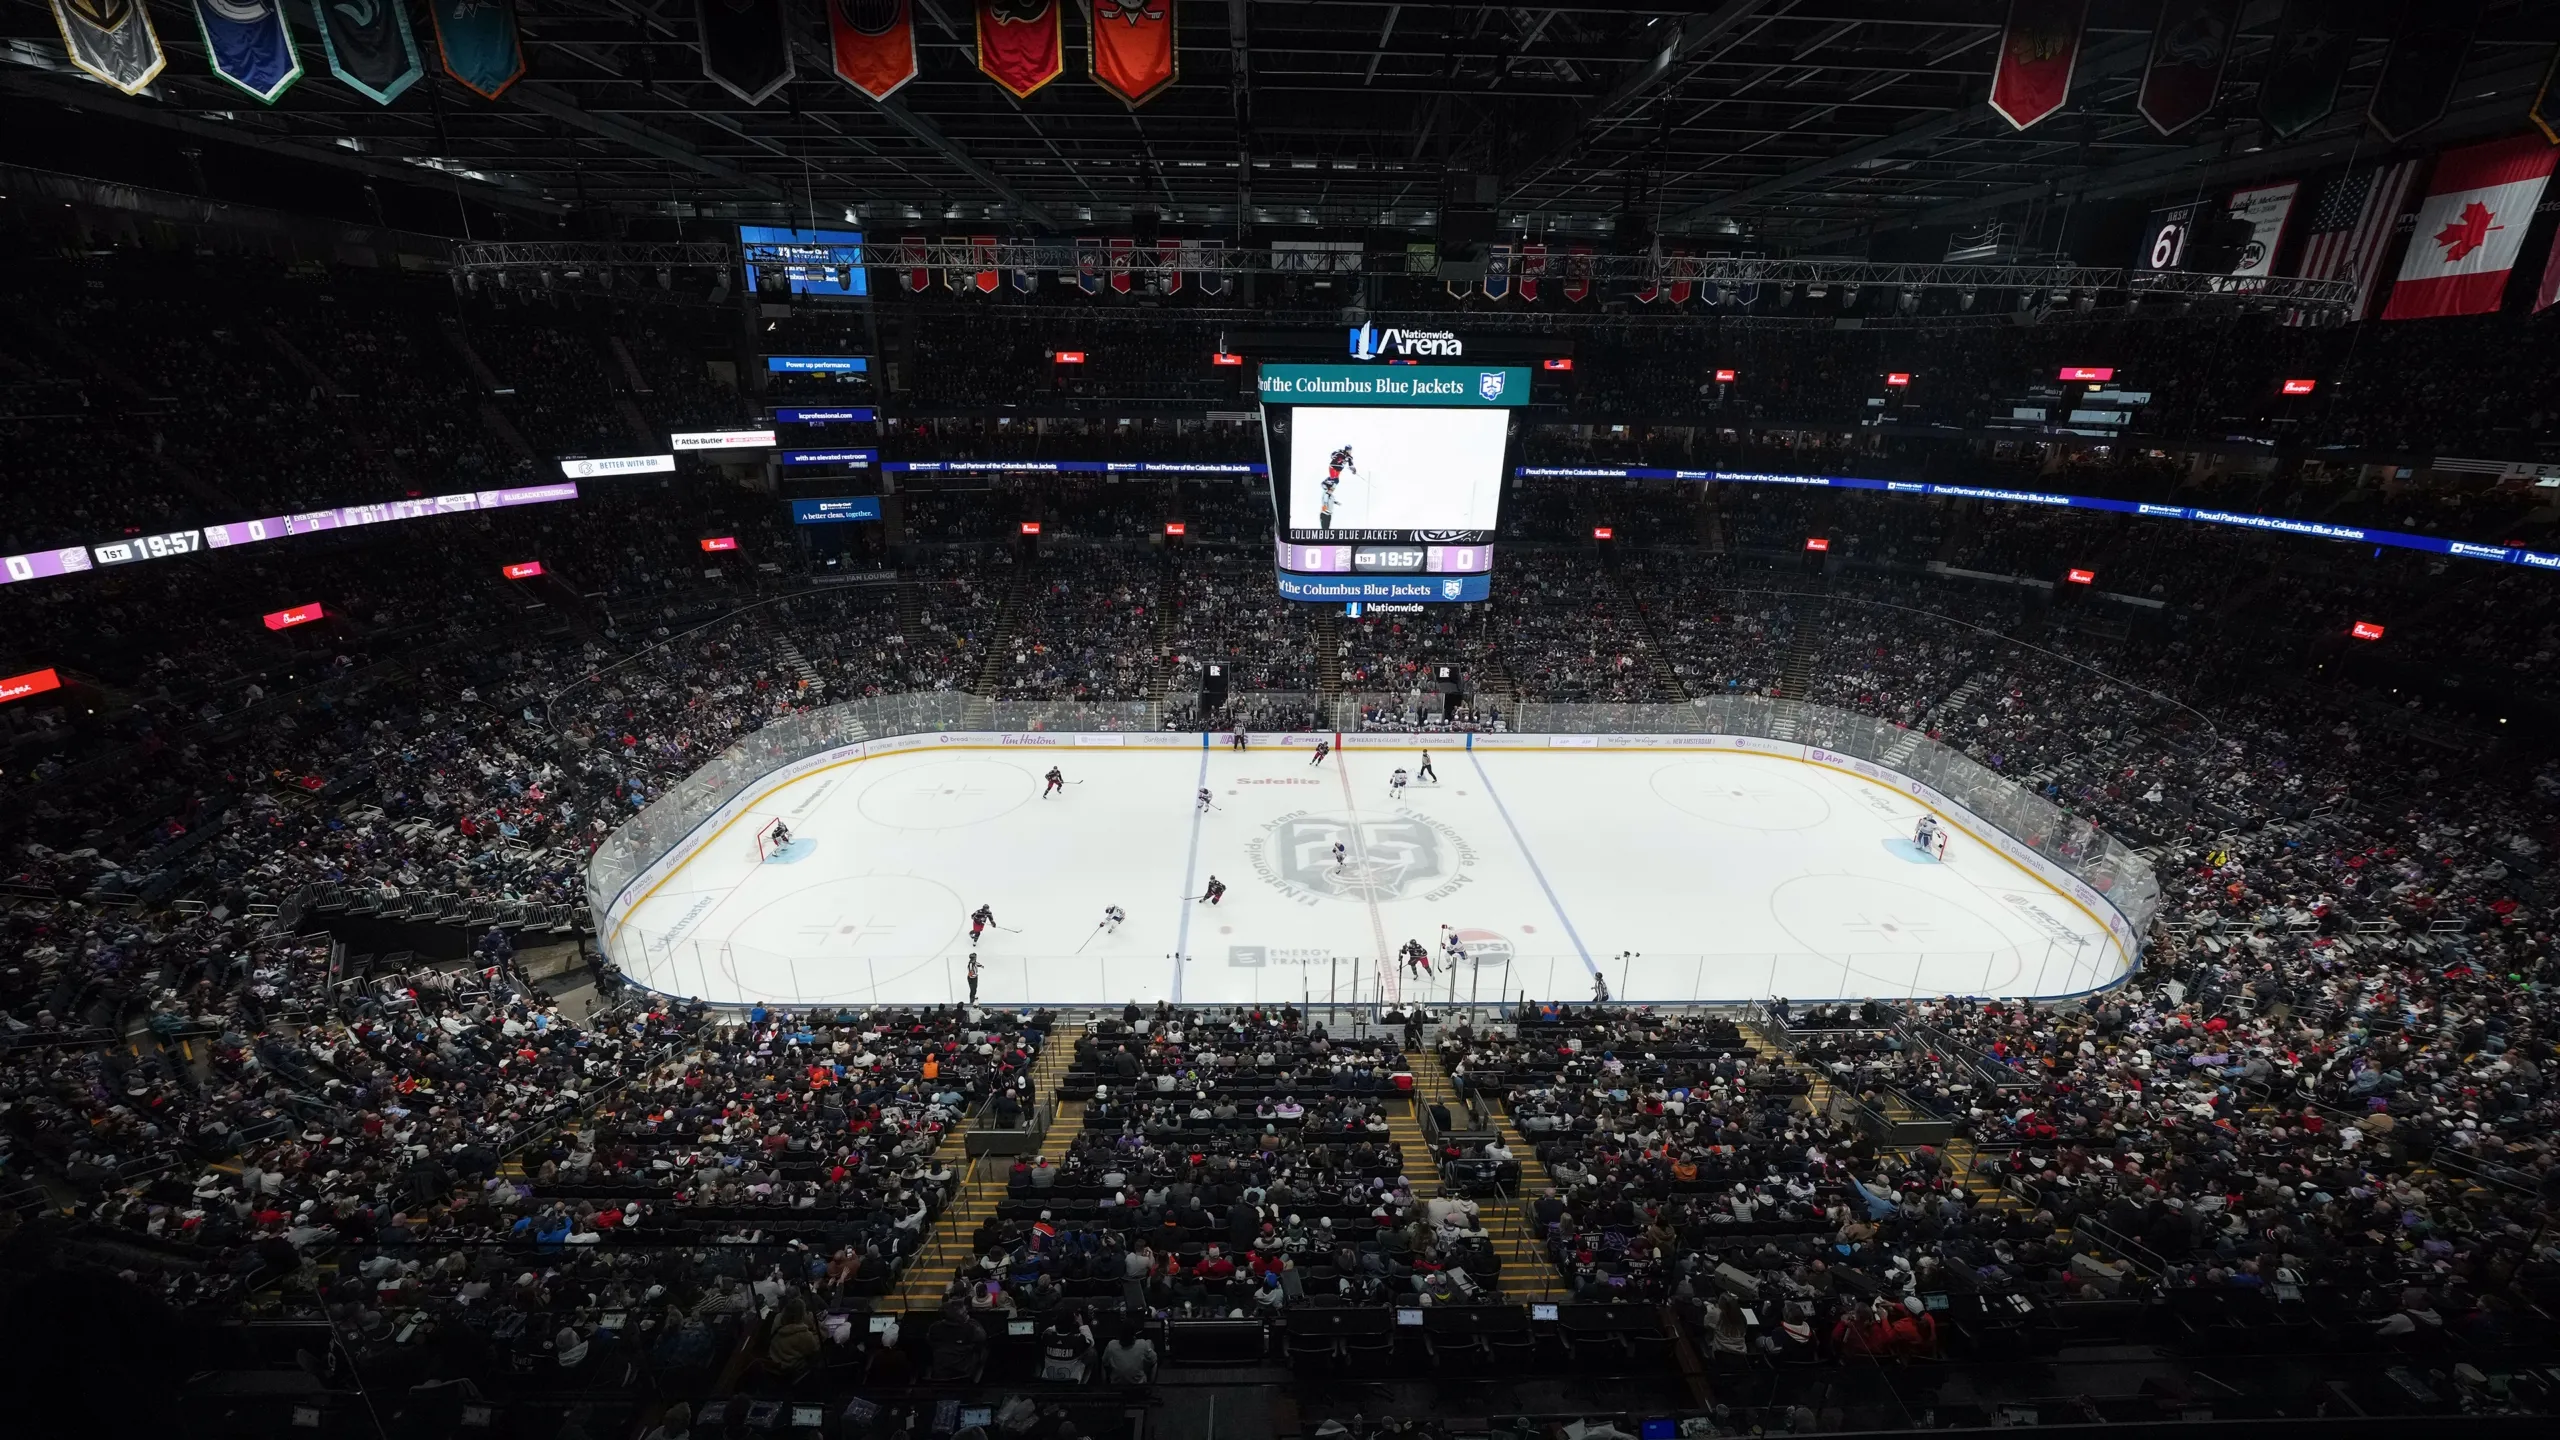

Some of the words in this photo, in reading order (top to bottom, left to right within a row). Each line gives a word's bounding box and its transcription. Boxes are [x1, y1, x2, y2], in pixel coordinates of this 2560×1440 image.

[2166, 209, 2189, 222] NASH
[2151, 224, 2187, 269] 61
[1401, 329, 1454, 340] Nationwide
[1377, 329, 1462, 356] Arena
[785, 361, 805, 369] Power
[814, 361, 851, 369] performance
[1272, 376, 1292, 393] the
[1296, 377, 1372, 394] Columbus
[1376, 378, 1409, 394] Blue
[1411, 378, 1464, 397] Jackets
[681, 436, 700, 445] Atlas
[700, 436, 723, 445] Butler
[817, 453, 841, 461] elevated
[600, 459, 625, 470] BETTER
[627, 459, 645, 468] WITH
[1146, 463, 1161, 471] Proud
[1525, 468, 1541, 476] Proud
[1541, 468, 1560, 476] Partner
[1573, 469, 1597, 477] Columbus
[1598, 469, 1609, 477] Blue
[1758, 474, 1768, 482] the
[1767, 475, 1796, 483] Columbus
[1796, 476, 1809, 484] Blue
[446, 495, 467, 503] SHOTS
[1934, 485, 1953, 494] Proud
[1953, 487, 1977, 495] Partner
[1977, 489, 1985, 497] of
[1985, 489, 1996, 497] the
[1995, 490, 2028, 501] Columbus
[2028, 493, 2044, 502] Blue
[2044, 494, 2069, 505] Jackets
[346, 505, 369, 515] POWER
[370, 503, 386, 512] PLAY
[808, 512, 826, 520] better
[827, 511, 845, 520] clean,
[845, 510, 873, 519] together.
[2195, 510, 2220, 521] Proud
[2220, 513, 2249, 524] Partner
[2248, 516, 2259, 525] of
[2257, 517, 2271, 527] the
[2271, 519, 2312, 532] Columbus
[2311, 524, 2332, 535] Blue
[2332, 525, 2365, 539] Jackets
[1290, 529, 1335, 540] COLUMBUS
[1338, 529, 1360, 540] BLUE
[1361, 529, 1398, 541] JACKETS
[5, 555, 33, 581] 0
[103, 550, 123, 560] 1ST
[133, 530, 200, 560] 19:57
[248, 520, 267, 541] 0
[1305, 548, 1322, 569] 0
[1360, 554, 1372, 563] 1ST
[1378, 551, 1424, 567] 19:57
[1457, 548, 1474, 570] 0
[2524, 553, 2558, 568] Proud
[1285, 580, 1301, 593] the
[1303, 583, 1361, 596] Columbus
[1363, 584, 1388, 596] Blue
[1390, 584, 1431, 597] Jackets
[1367, 603, 1424, 613] Nationwide
[1001, 734, 1019, 745] Tim
[1020, 734, 1057, 745] Hortons
[831, 748, 860, 760] ESPN+
[792, 757, 827, 774] OhioHealth
[1260, 808, 1308, 833] Arena
[666, 836, 700, 869] ticketmaster
[2011, 846, 2045, 872] OhioHealth
[1424, 873, 1474, 902] Arena
[1270, 948, 1331, 957] ENERGY
